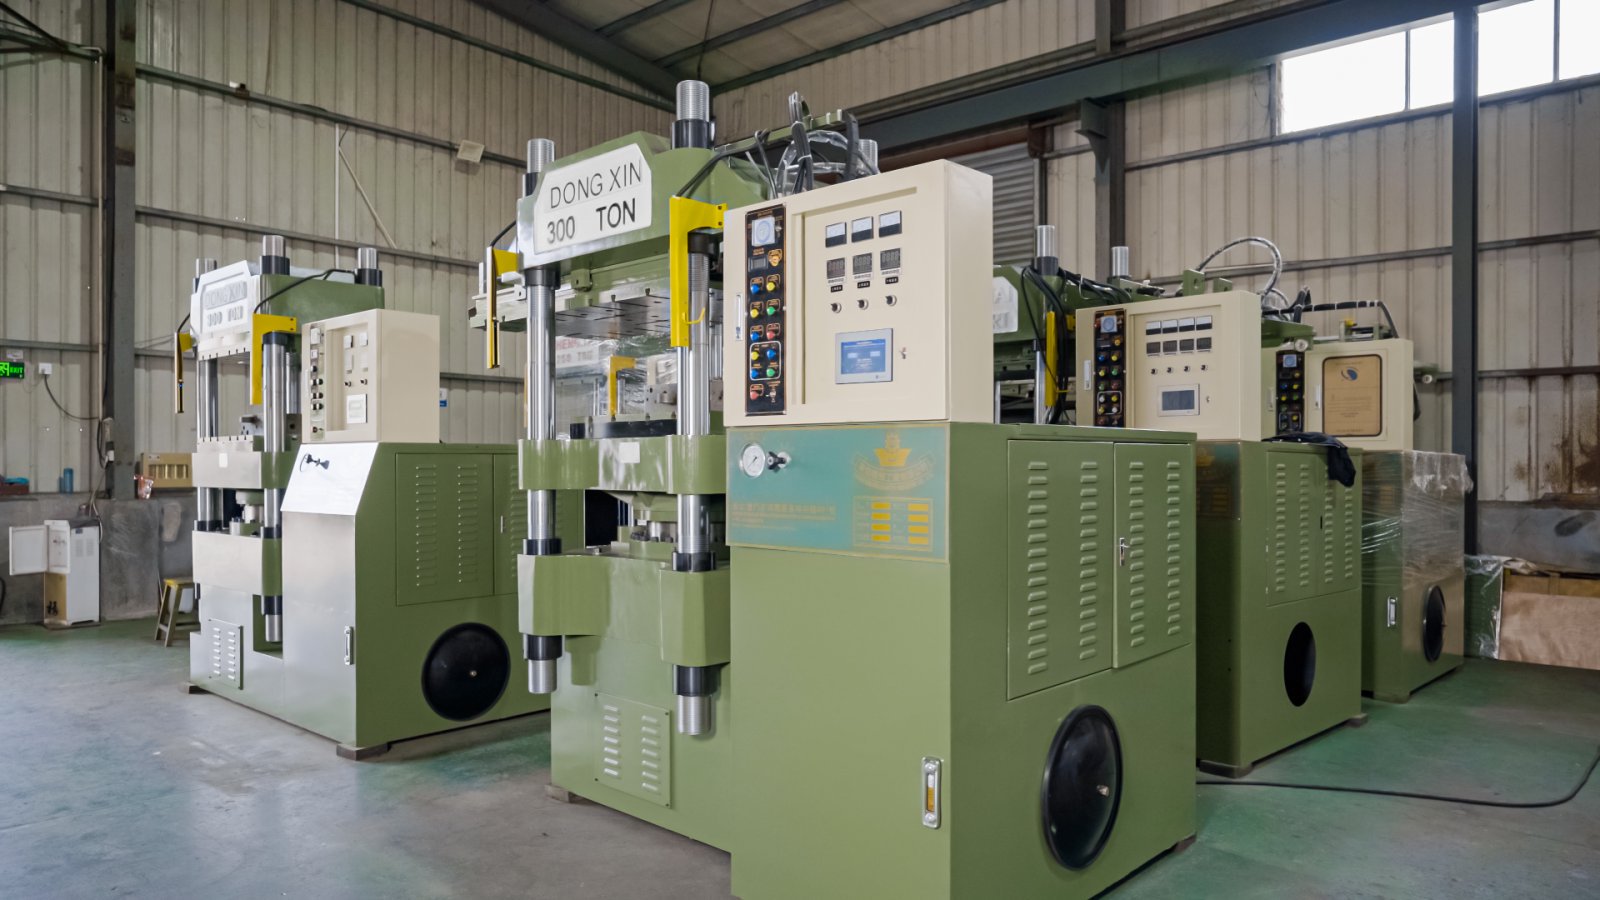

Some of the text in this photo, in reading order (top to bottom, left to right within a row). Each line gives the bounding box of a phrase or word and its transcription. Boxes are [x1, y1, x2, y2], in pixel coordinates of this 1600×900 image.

[550, 159, 642, 209] DONG XIN
[547, 198, 636, 244] 300 TON
